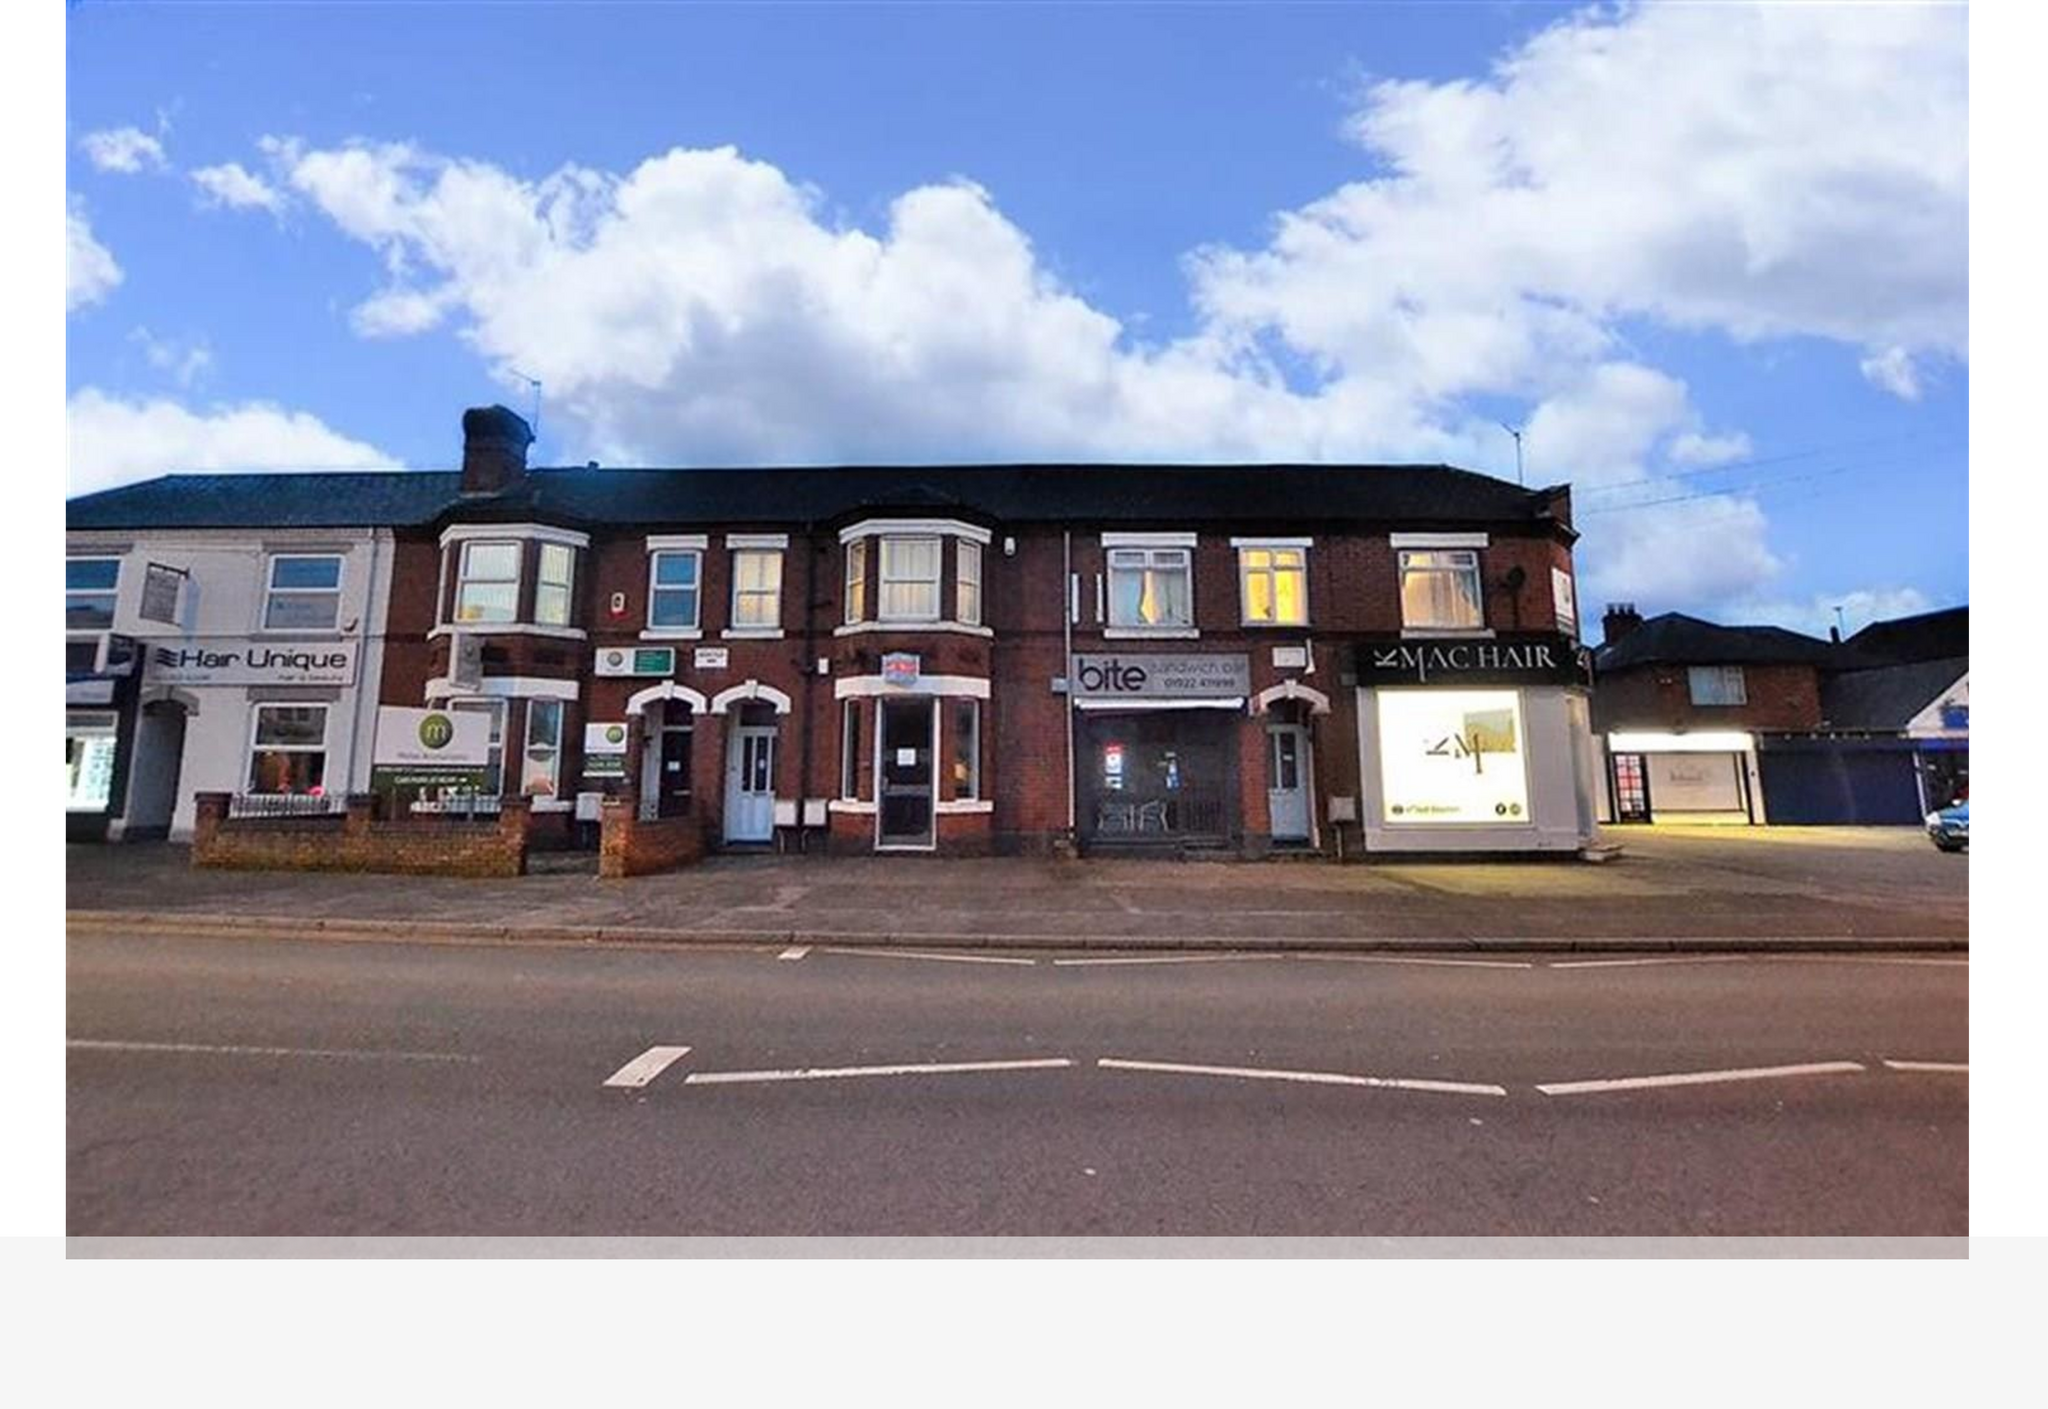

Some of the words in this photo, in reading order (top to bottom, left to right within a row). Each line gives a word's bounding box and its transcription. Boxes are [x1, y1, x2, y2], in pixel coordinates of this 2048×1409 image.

[179, 649, 240, 668] Hair
[247, 649, 347, 672] Unique
[1478, 646, 1555, 668] HAIR
[1078, 658, 1147, 691] bite
